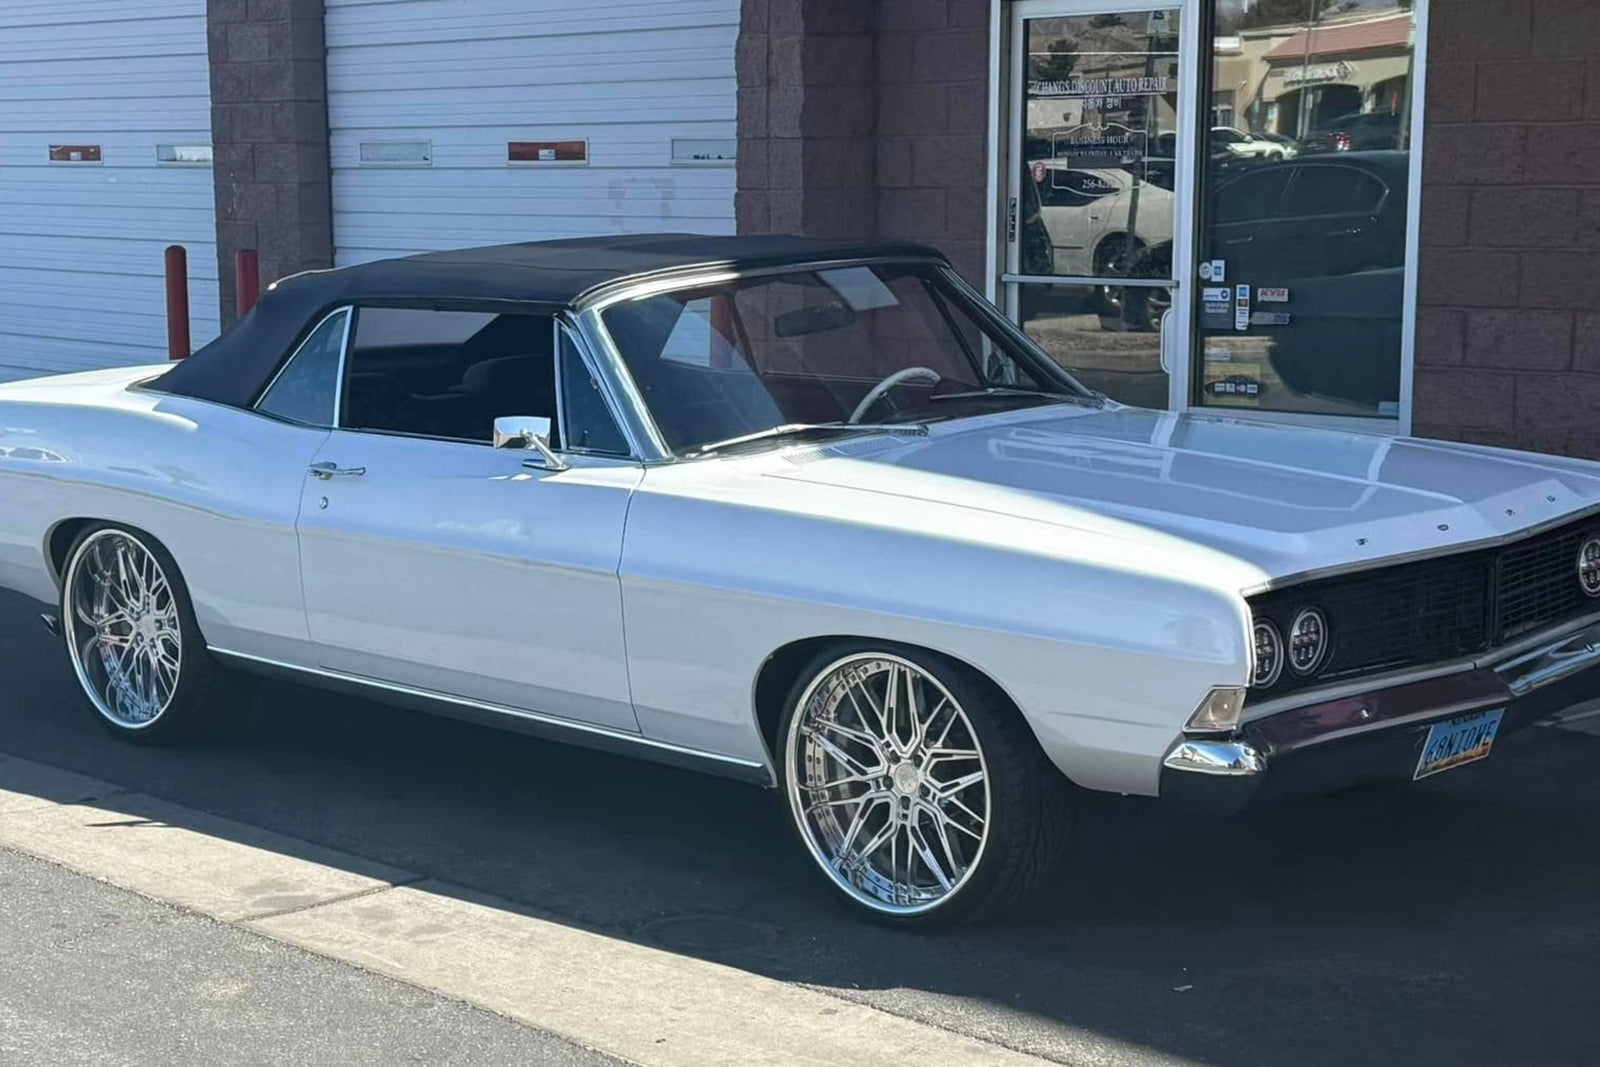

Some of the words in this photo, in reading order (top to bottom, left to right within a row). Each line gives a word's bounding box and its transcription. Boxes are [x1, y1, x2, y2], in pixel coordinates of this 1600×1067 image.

[1071, 79, 1113, 94] DISCOUNT
[1114, 78, 1138, 93] AUTO
[1139, 76, 1167, 92] REPAIR
[1070, 135, 1105, 145] BUSINESS
